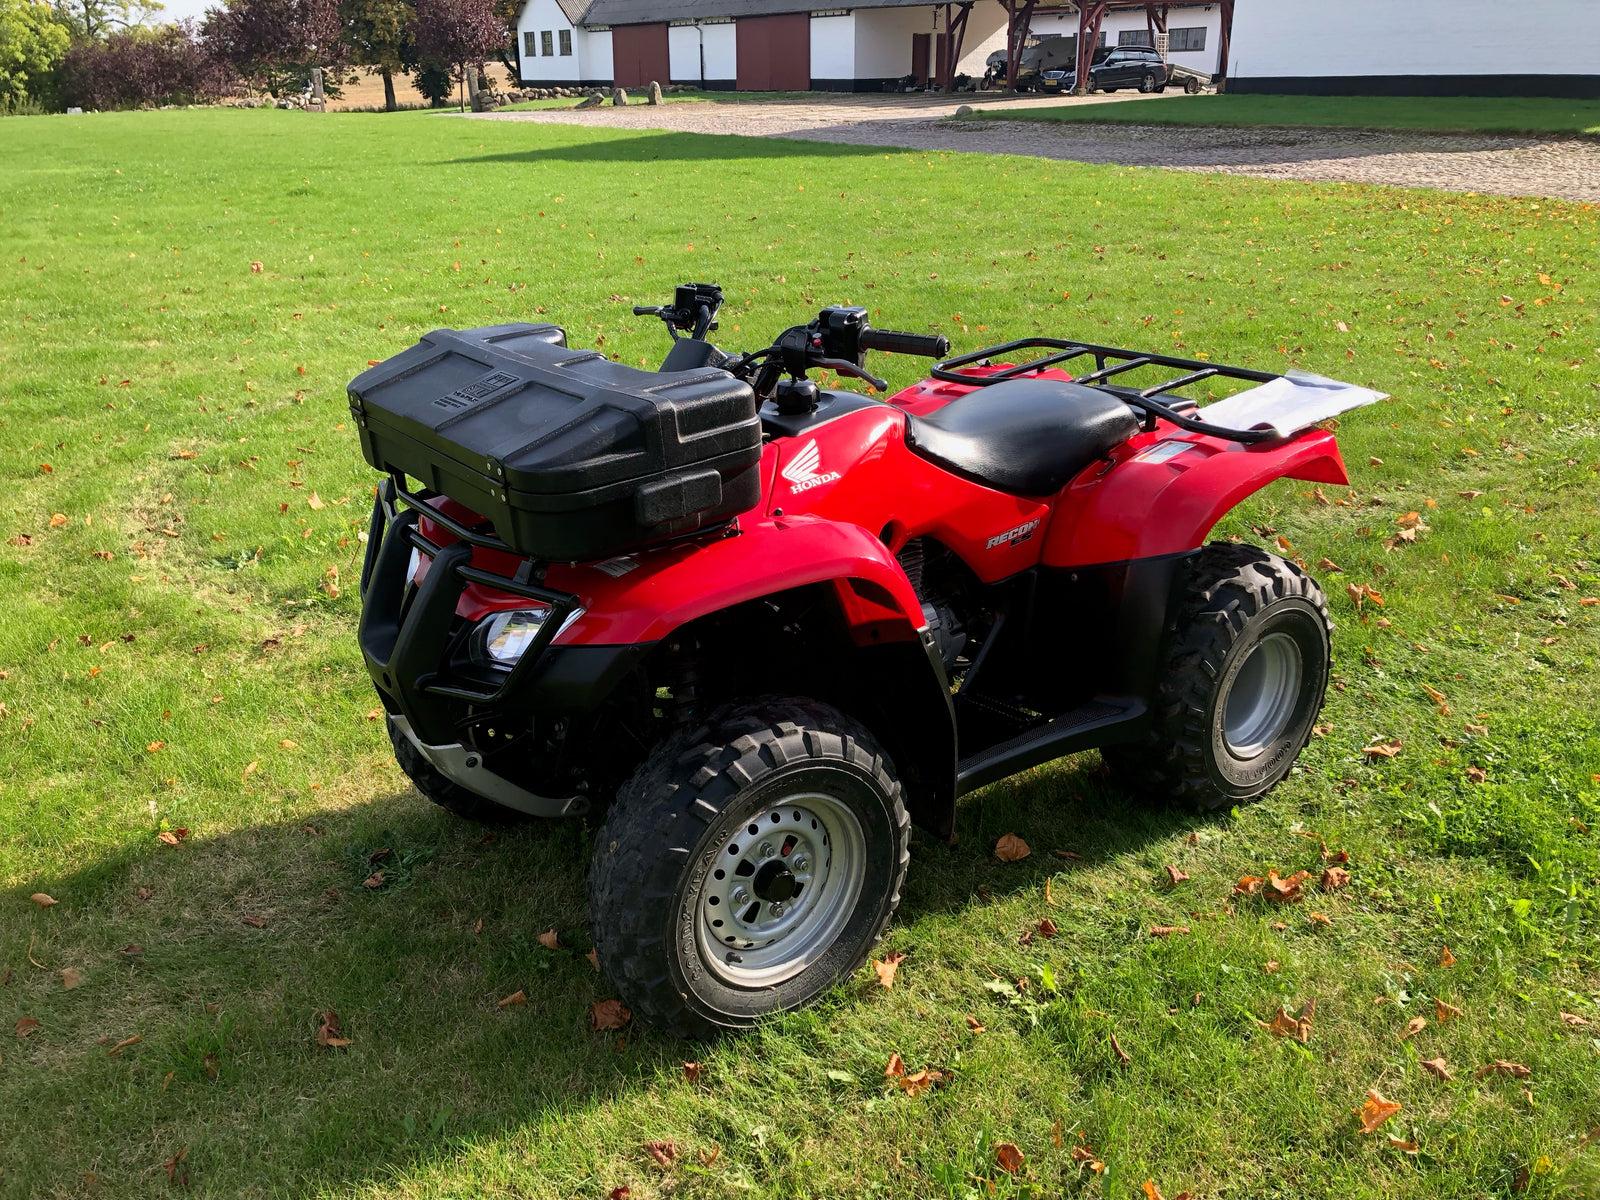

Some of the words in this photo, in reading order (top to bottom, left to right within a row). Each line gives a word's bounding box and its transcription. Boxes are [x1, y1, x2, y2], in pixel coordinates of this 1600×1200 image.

[790, 472, 842, 495] HONDA
[986, 517, 1041, 549] RECON
[682, 831, 729, 981] GOODYEAR
